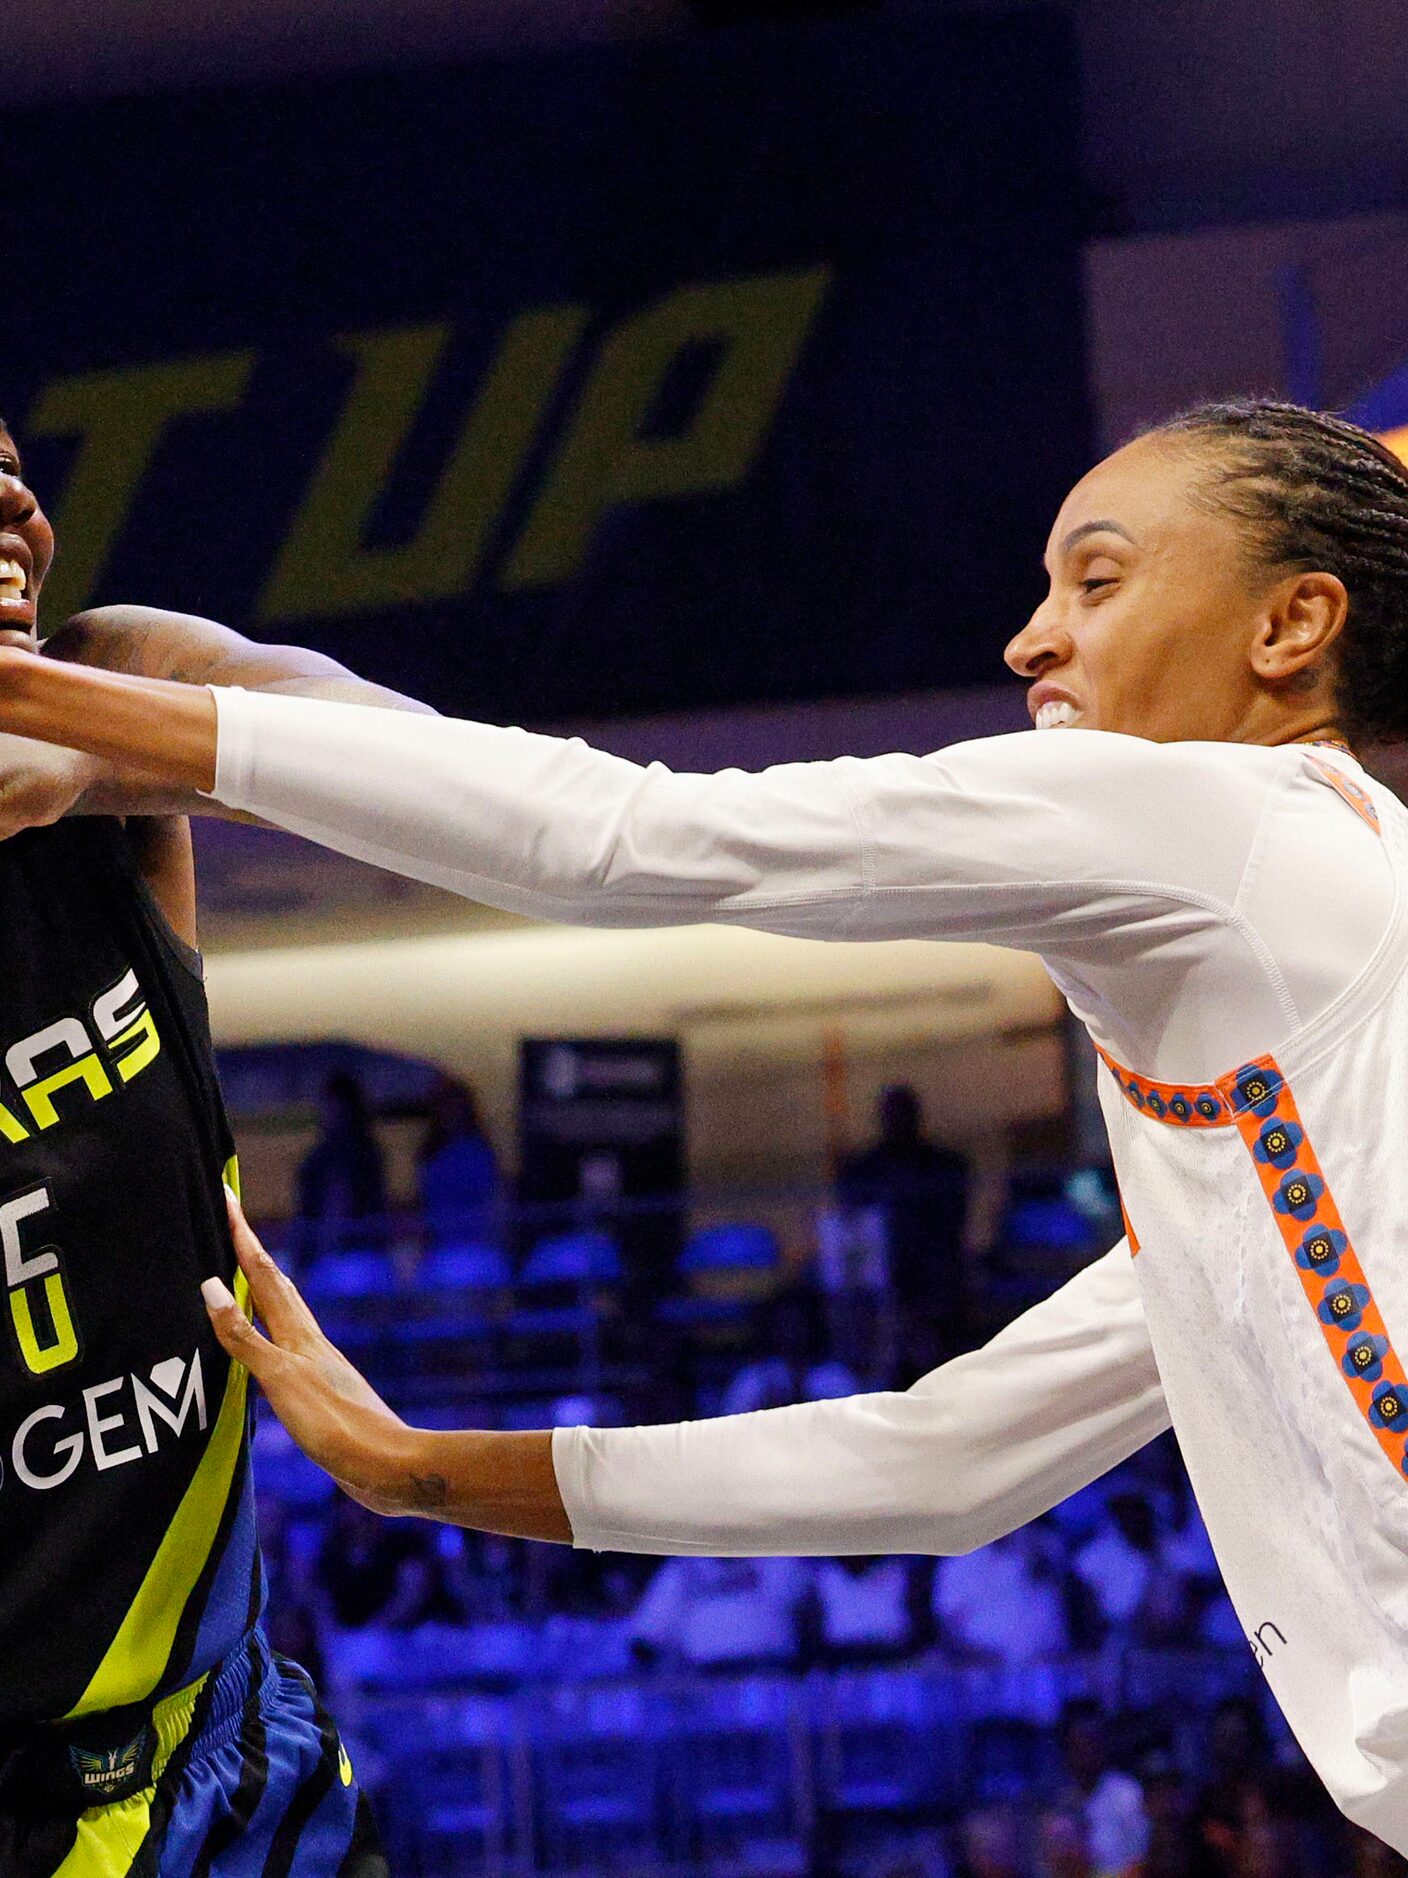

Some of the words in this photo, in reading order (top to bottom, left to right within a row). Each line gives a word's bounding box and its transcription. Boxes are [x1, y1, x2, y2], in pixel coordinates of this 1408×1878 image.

[258, 265, 832, 625] UP
[12, 1348, 208, 1490] GEM
[84, 1761, 135, 1785] WINGS
